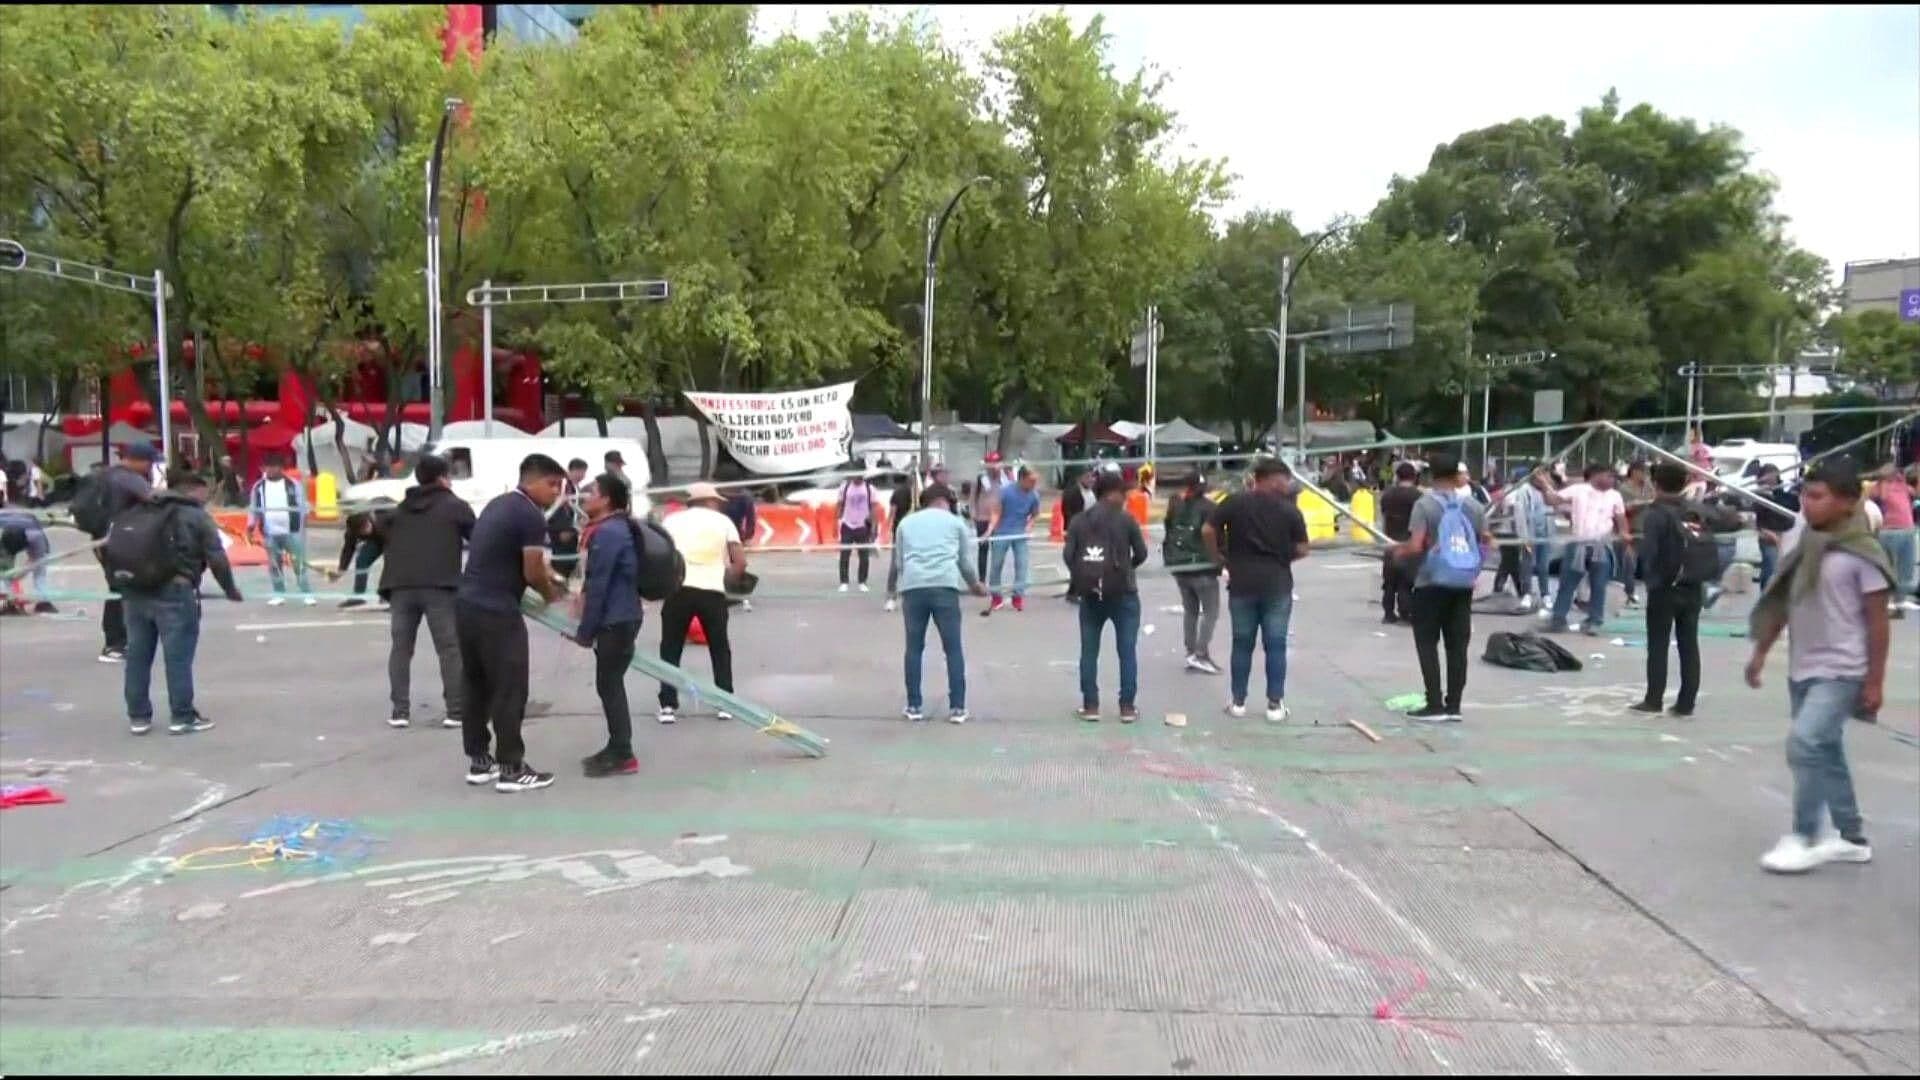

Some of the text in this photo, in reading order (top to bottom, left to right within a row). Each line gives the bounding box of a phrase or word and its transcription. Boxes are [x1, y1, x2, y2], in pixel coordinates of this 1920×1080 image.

[781, 397, 794, 410] ES
[797, 397, 811, 408] UN
[728, 413, 784, 426] LIBERTAD
[787, 410, 813, 424] PERO
[719, 426, 771, 441] OBIERNO
[775, 428, 794, 440] NOS
